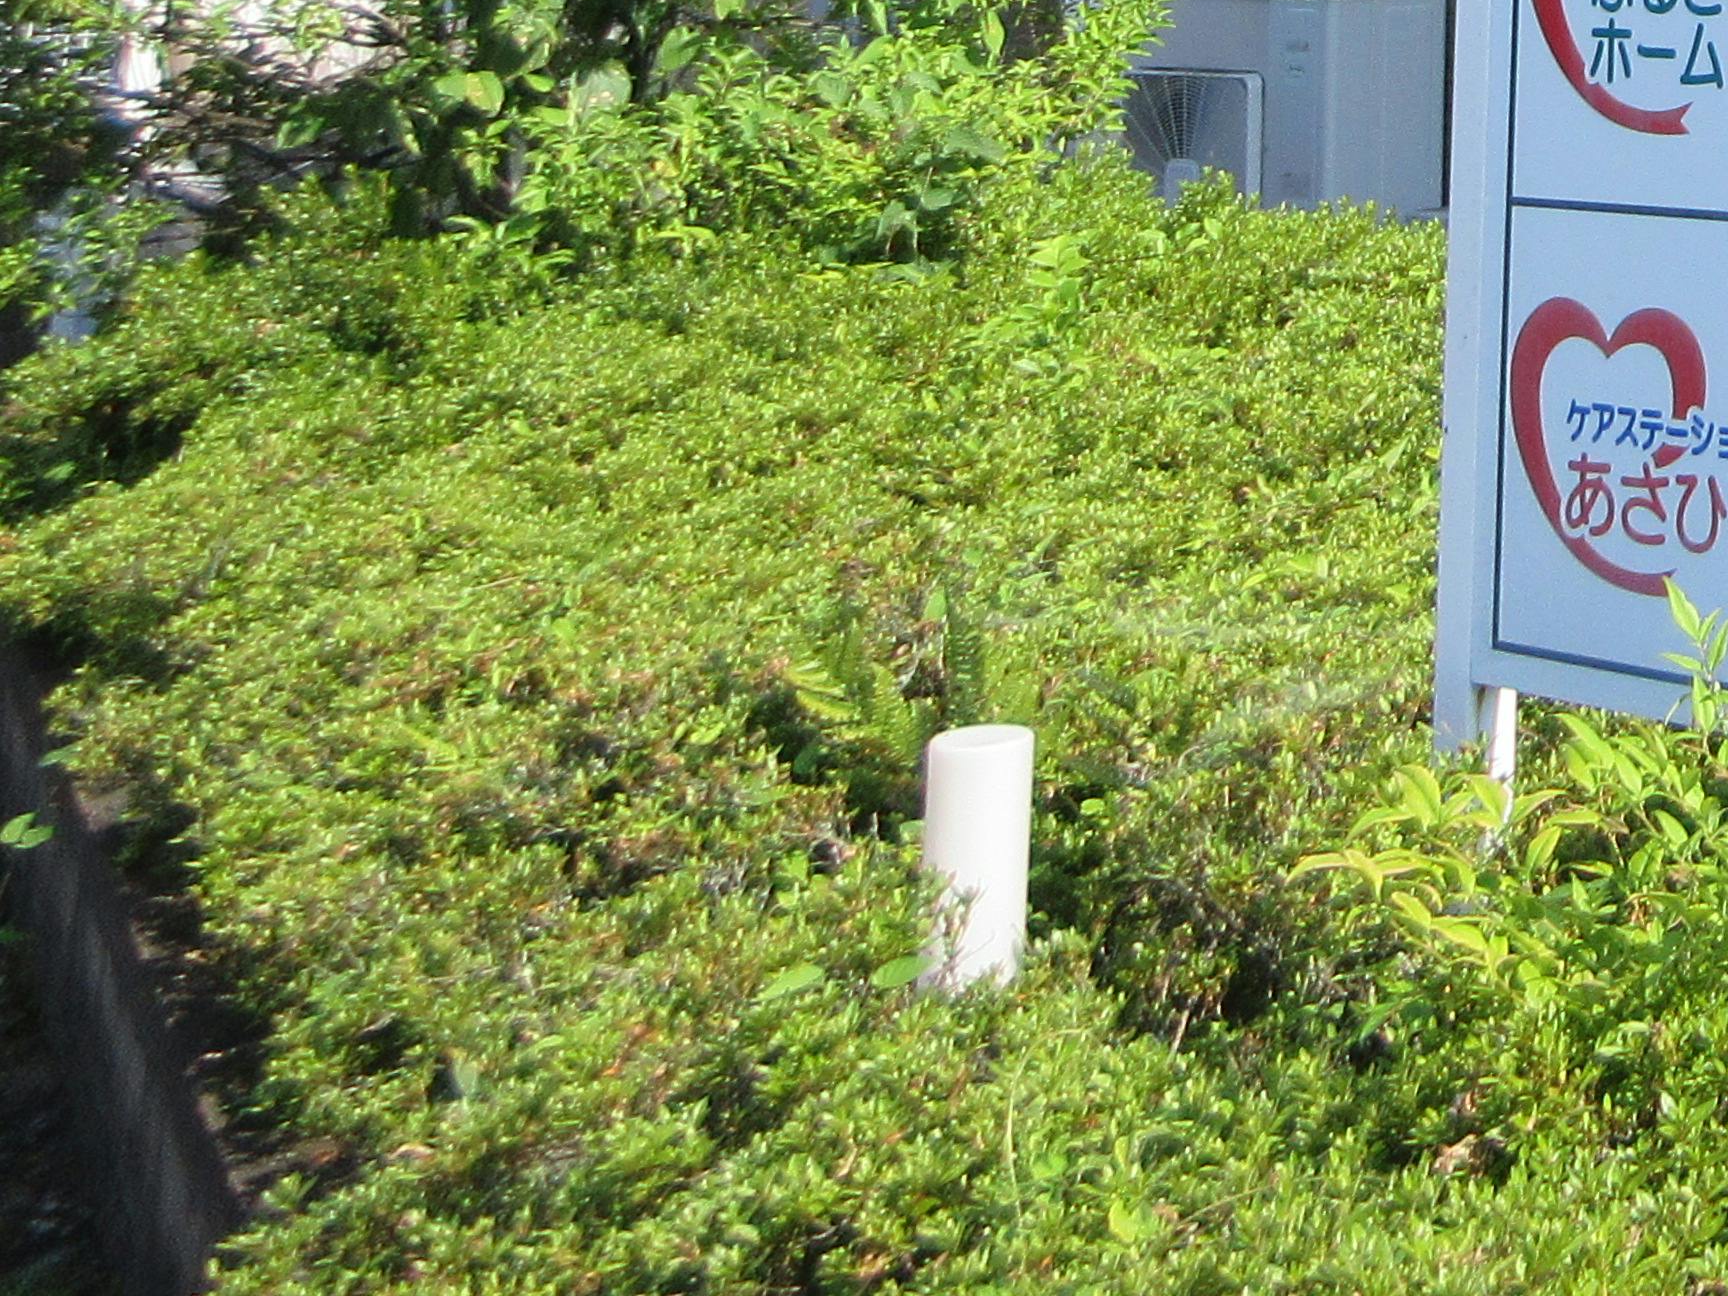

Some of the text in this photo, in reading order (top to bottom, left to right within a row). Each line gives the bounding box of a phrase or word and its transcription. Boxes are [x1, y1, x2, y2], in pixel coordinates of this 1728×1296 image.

[1588, 16, 1726, 91] ホーム
[1563, 452, 1728, 555] あさひ
